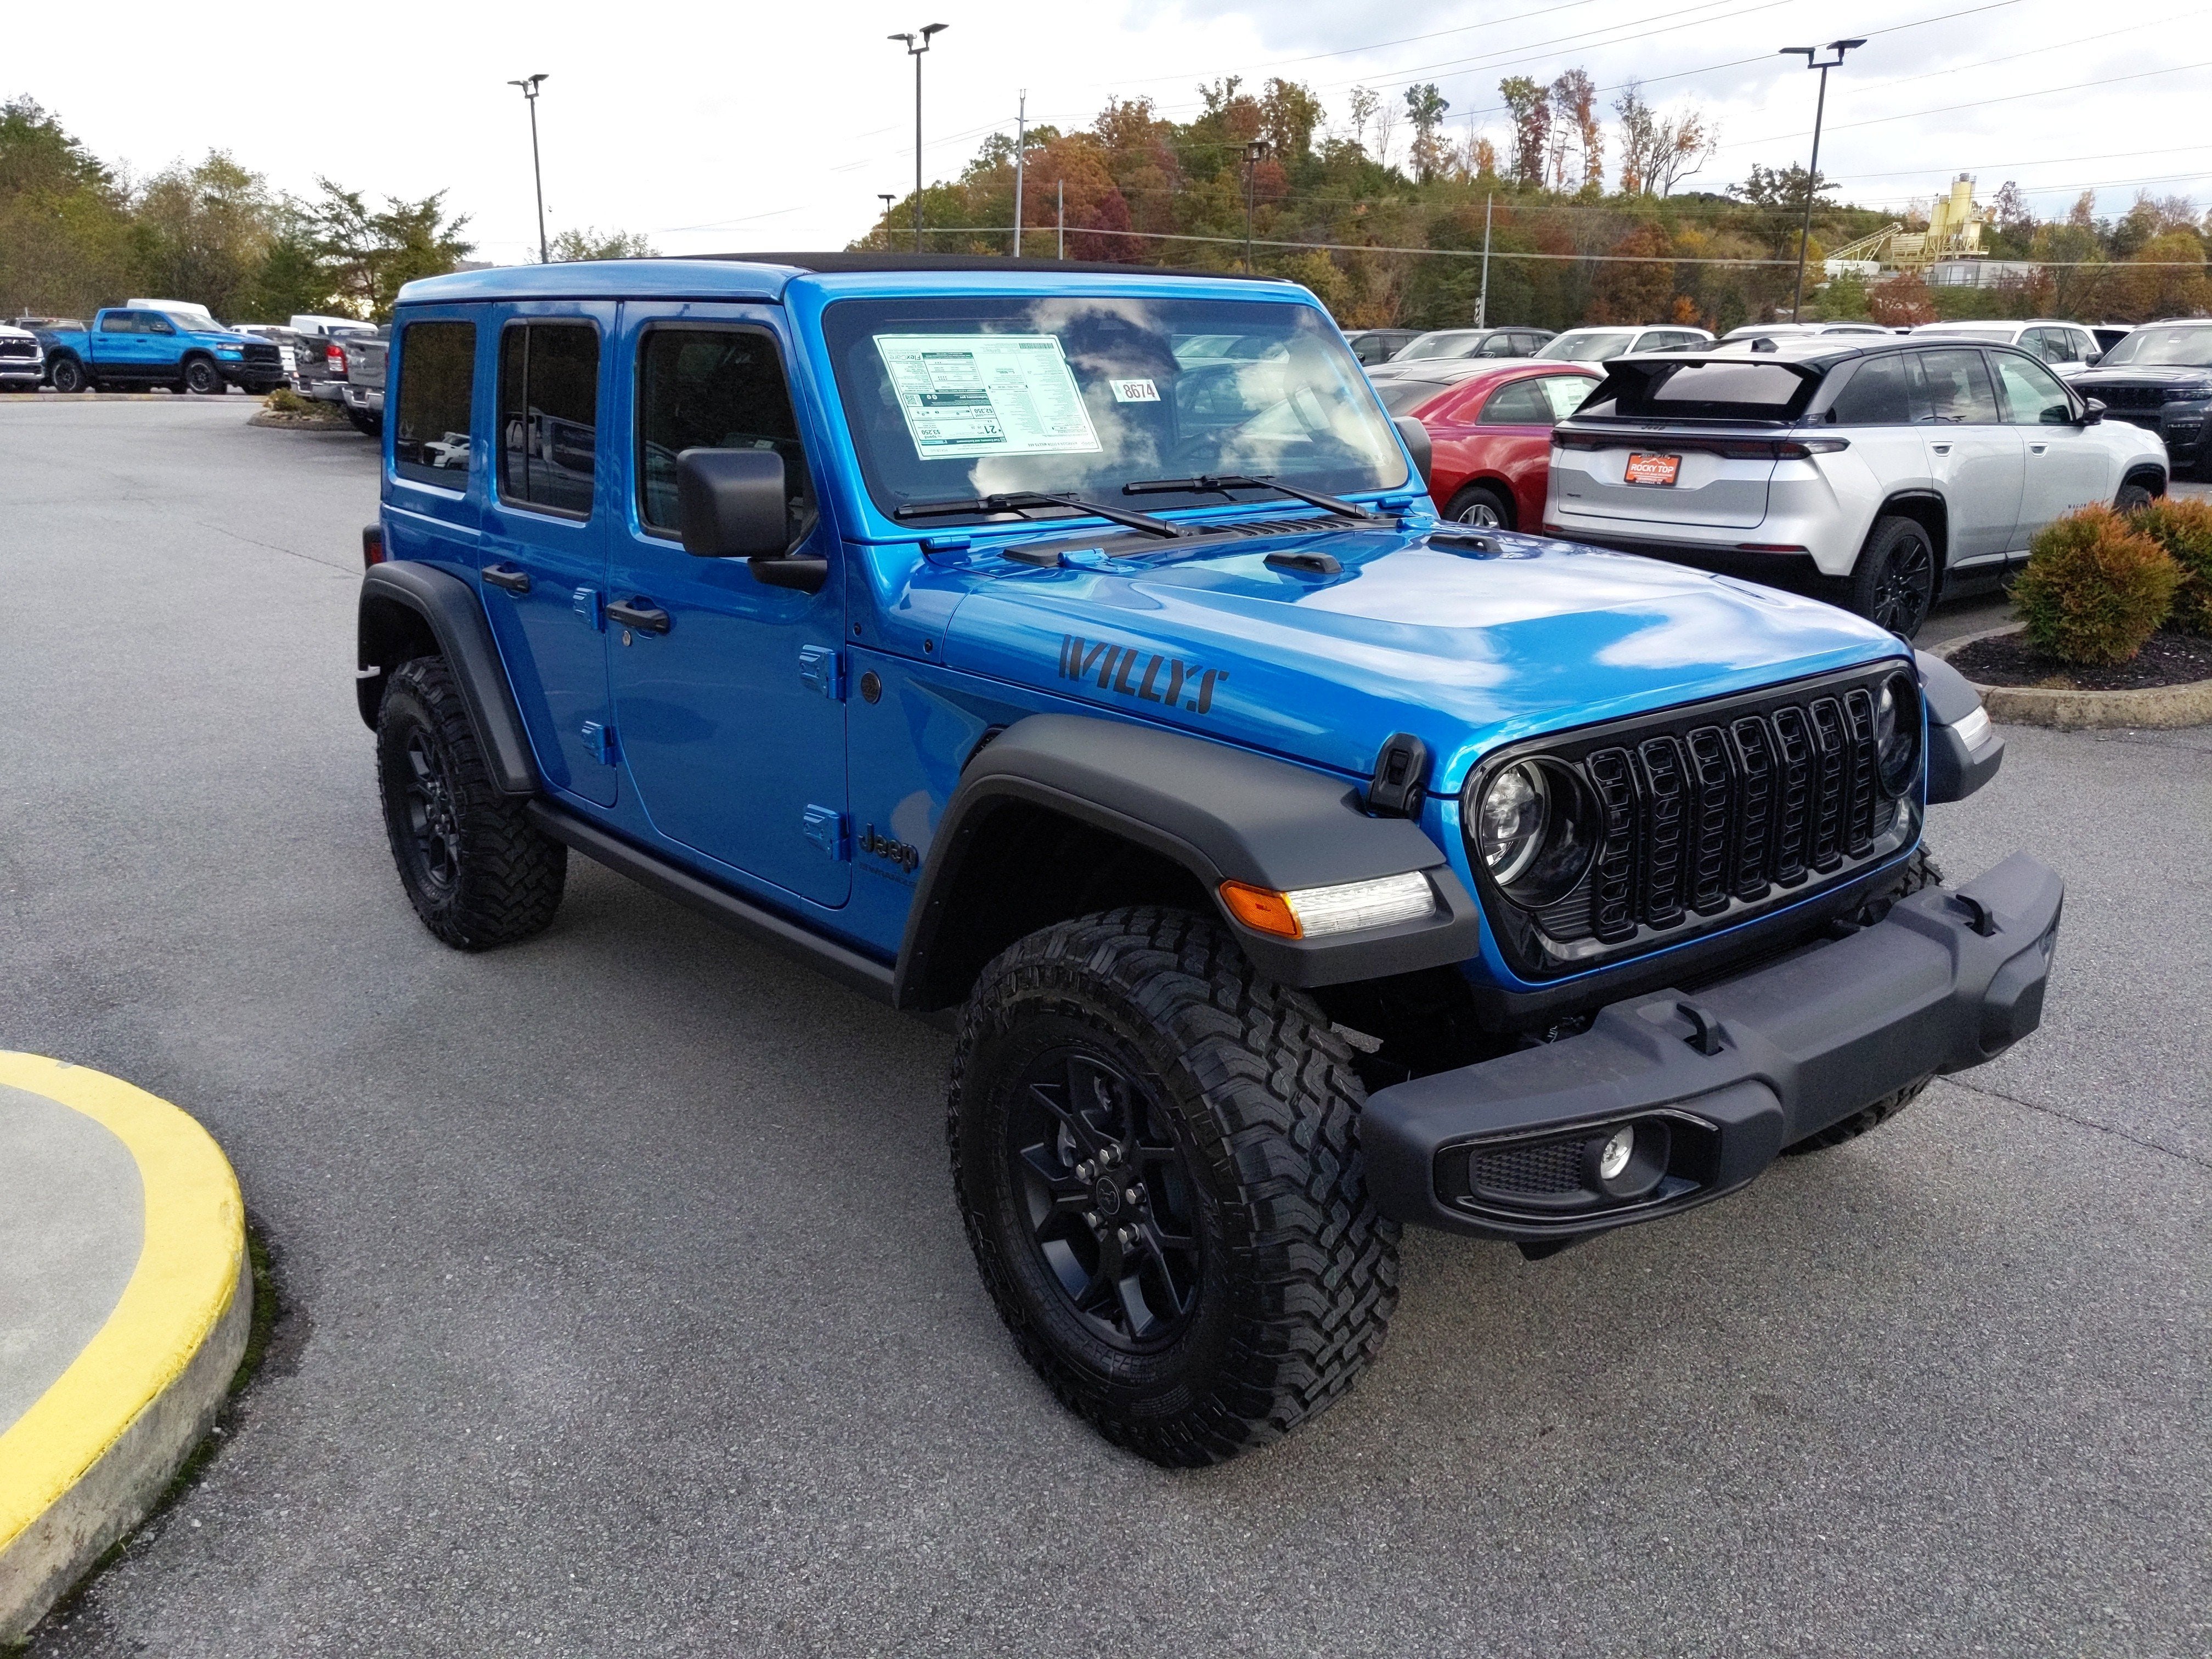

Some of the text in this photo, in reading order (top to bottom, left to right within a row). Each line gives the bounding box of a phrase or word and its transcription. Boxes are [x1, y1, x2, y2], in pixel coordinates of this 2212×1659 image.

[1122, 384, 1155, 398] 8674
[983, 425, 997, 433] 21
[1630, 464, 1674, 473] ROCKY TOP
[1059, 634, 1230, 714] WILLYS
[858, 822, 919, 874] Jeep
